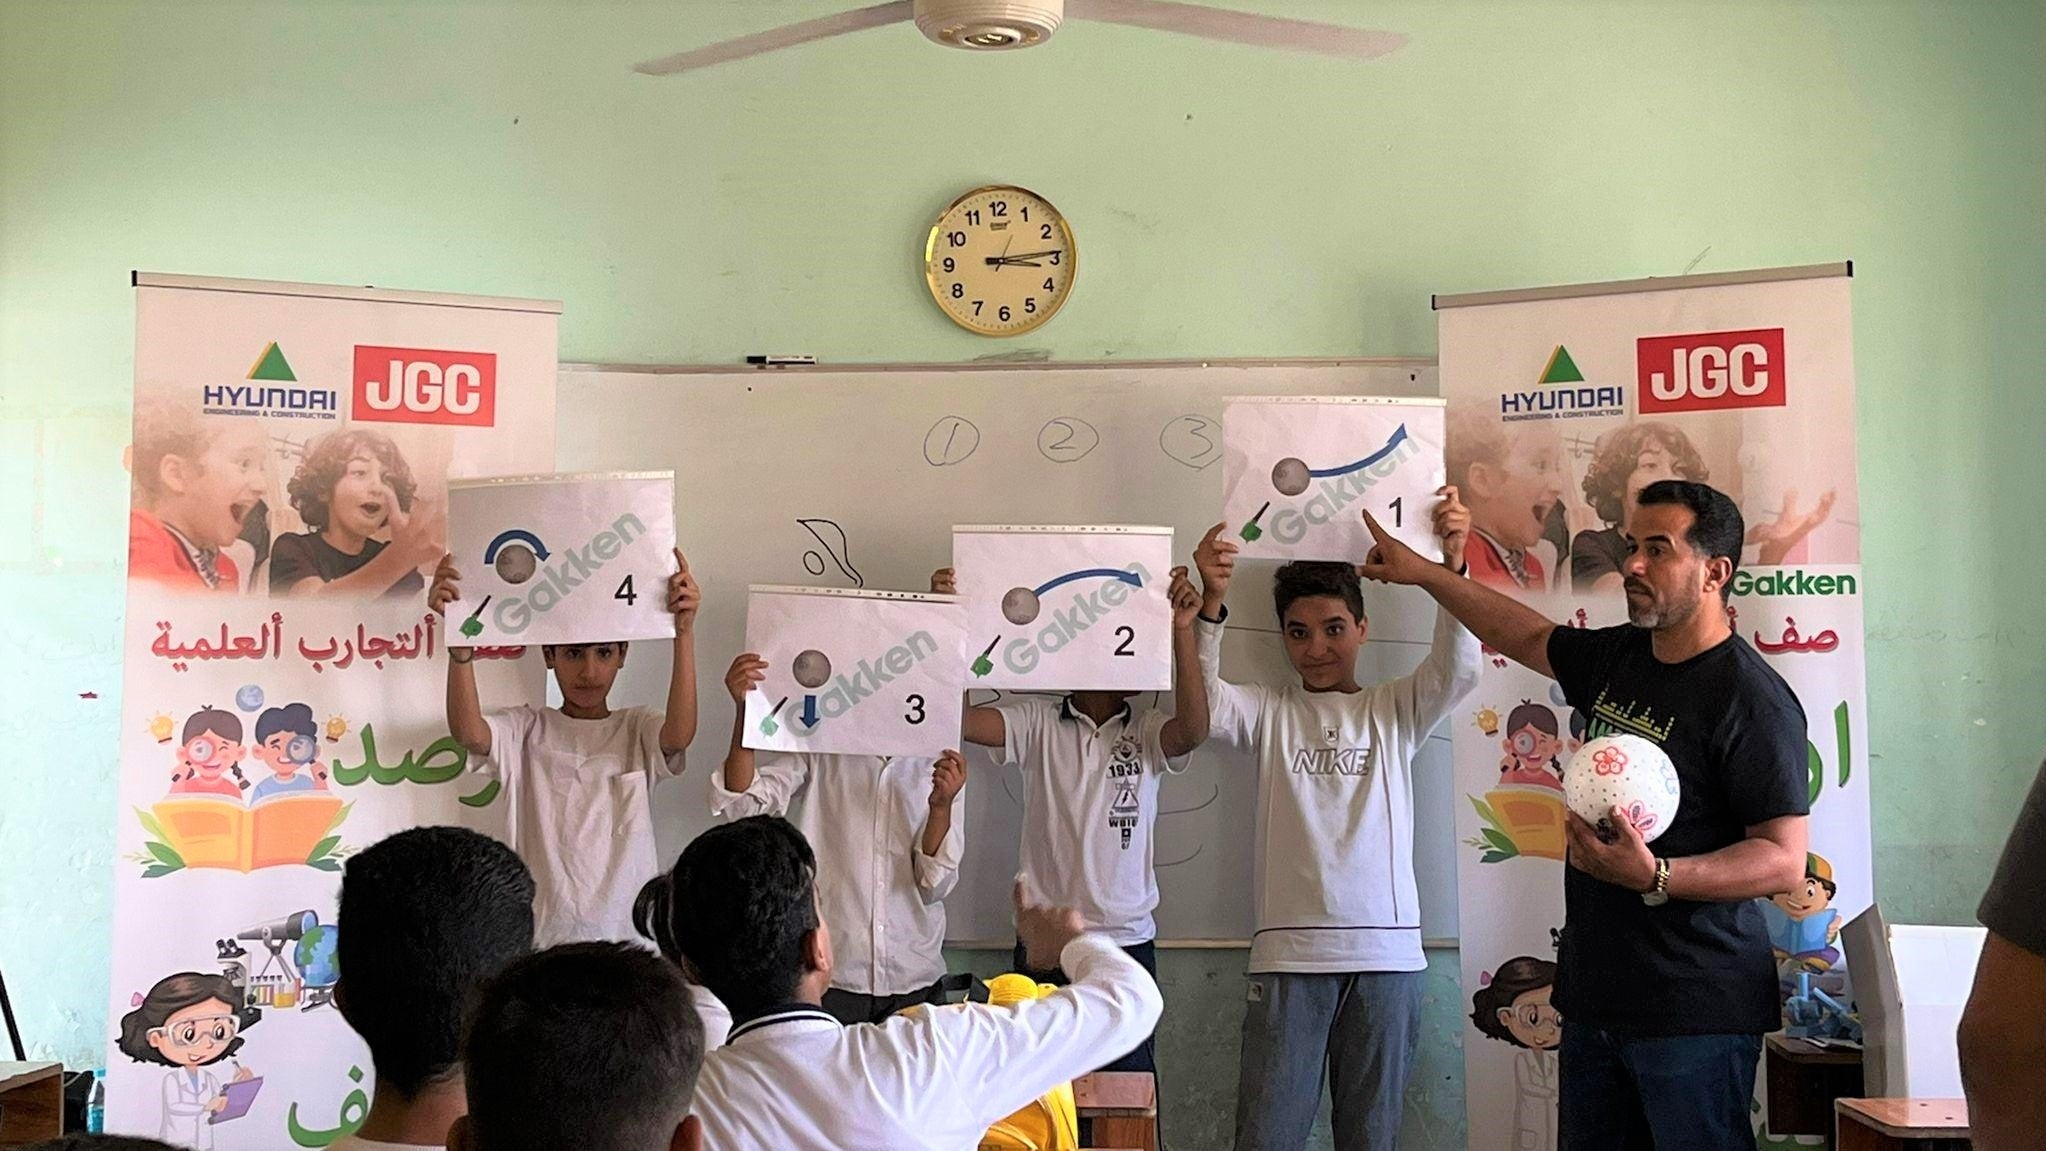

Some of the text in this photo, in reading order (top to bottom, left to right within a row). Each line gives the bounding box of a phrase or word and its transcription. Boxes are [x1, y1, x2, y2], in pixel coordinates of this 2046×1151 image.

[989, 201, 1008, 217] 12
[1020, 206, 1029, 222] 1
[965, 210, 980, 226] 11
[947, 231, 966, 247] 10
[1040, 224, 1053, 240] 2
[943, 257, 955, 273] 9
[1049, 250, 1061, 266] 3
[952, 283, 964, 298] 8
[1043, 277, 1055, 292] 4
[972, 301, 984, 316] 7
[999, 306, 1011, 321] 6
[1025, 298, 1036, 313] 5
[1651, 343, 1769, 401] JGC
[366, 360, 481, 415] JGC
[204, 385, 336, 410] HYUNDAI
[1501, 386, 1623, 413] HYUNDAI
[271, 410, 336, 419] CONSTRUCTION
[1562, 409, 1623, 418] CONSTRUCTION
[1389, 497, 1402, 527] 1
[493, 512, 647, 635] Gakken
[614, 574, 637, 606] 4
[1731, 570, 1857, 597] Gakken
[1113, 625, 1135, 656] 2
[1754, 616, 1840, 656] صف
[904, 694, 926, 725] 3
[1108, 761, 1140, 777] 1933
[1292, 748, 1371, 776] NIKE
